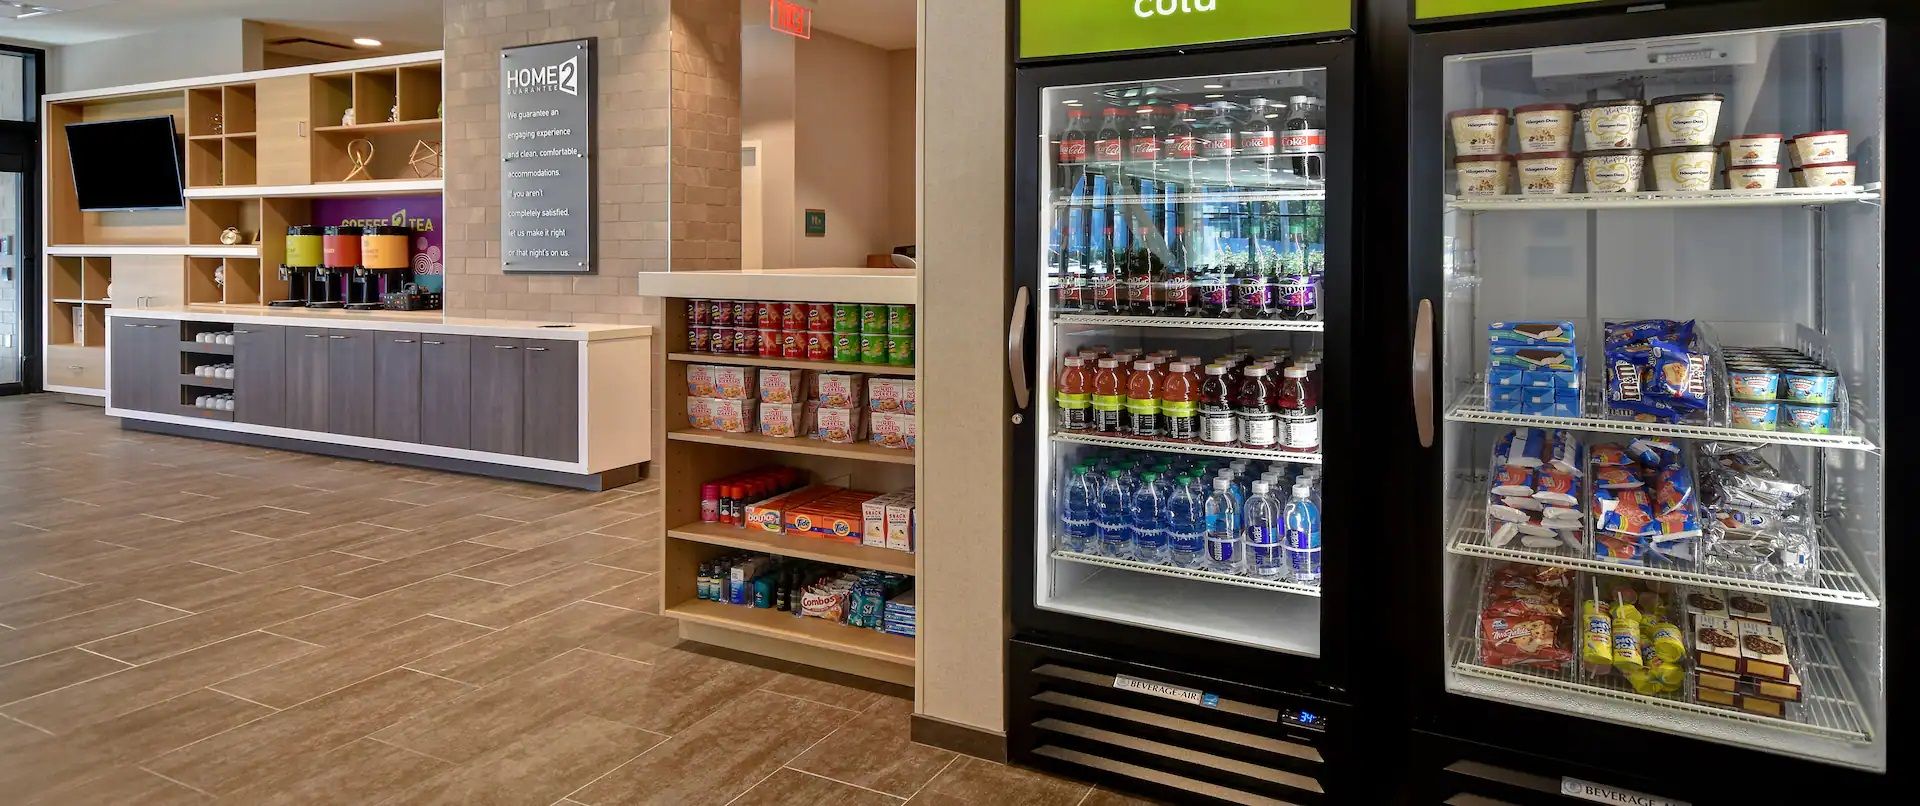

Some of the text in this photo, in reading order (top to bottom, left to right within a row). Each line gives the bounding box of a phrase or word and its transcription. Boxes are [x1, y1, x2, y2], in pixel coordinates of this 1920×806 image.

[507, 85, 558, 95] GUARANTEE
[507, 111, 518, 119] We
[518, 109, 550, 120] guarantee
[507, 128, 571, 141] engaging experience
[1281, 136, 1306, 147] Coke
[507, 169, 561, 178] accommodations.
[513, 191, 525, 200] you
[525, 188, 543, 197] aren't
[508, 209, 541, 219] completely
[409, 218, 433, 232] TEA
[508, 229, 516, 237] let
[526, 229, 544, 237] make
[550, 229, 566, 239] right
[515, 249, 528, 257] that
[529, 249, 550, 258] night's
[796, 517, 811, 528] Tide
[835, 522, 849, 533] Tide
[803, 594, 836, 608] Combos
[1130, 681, 1198, 700] BEVERAGE-AIR
[1299, 711, 1313, 723] 34
